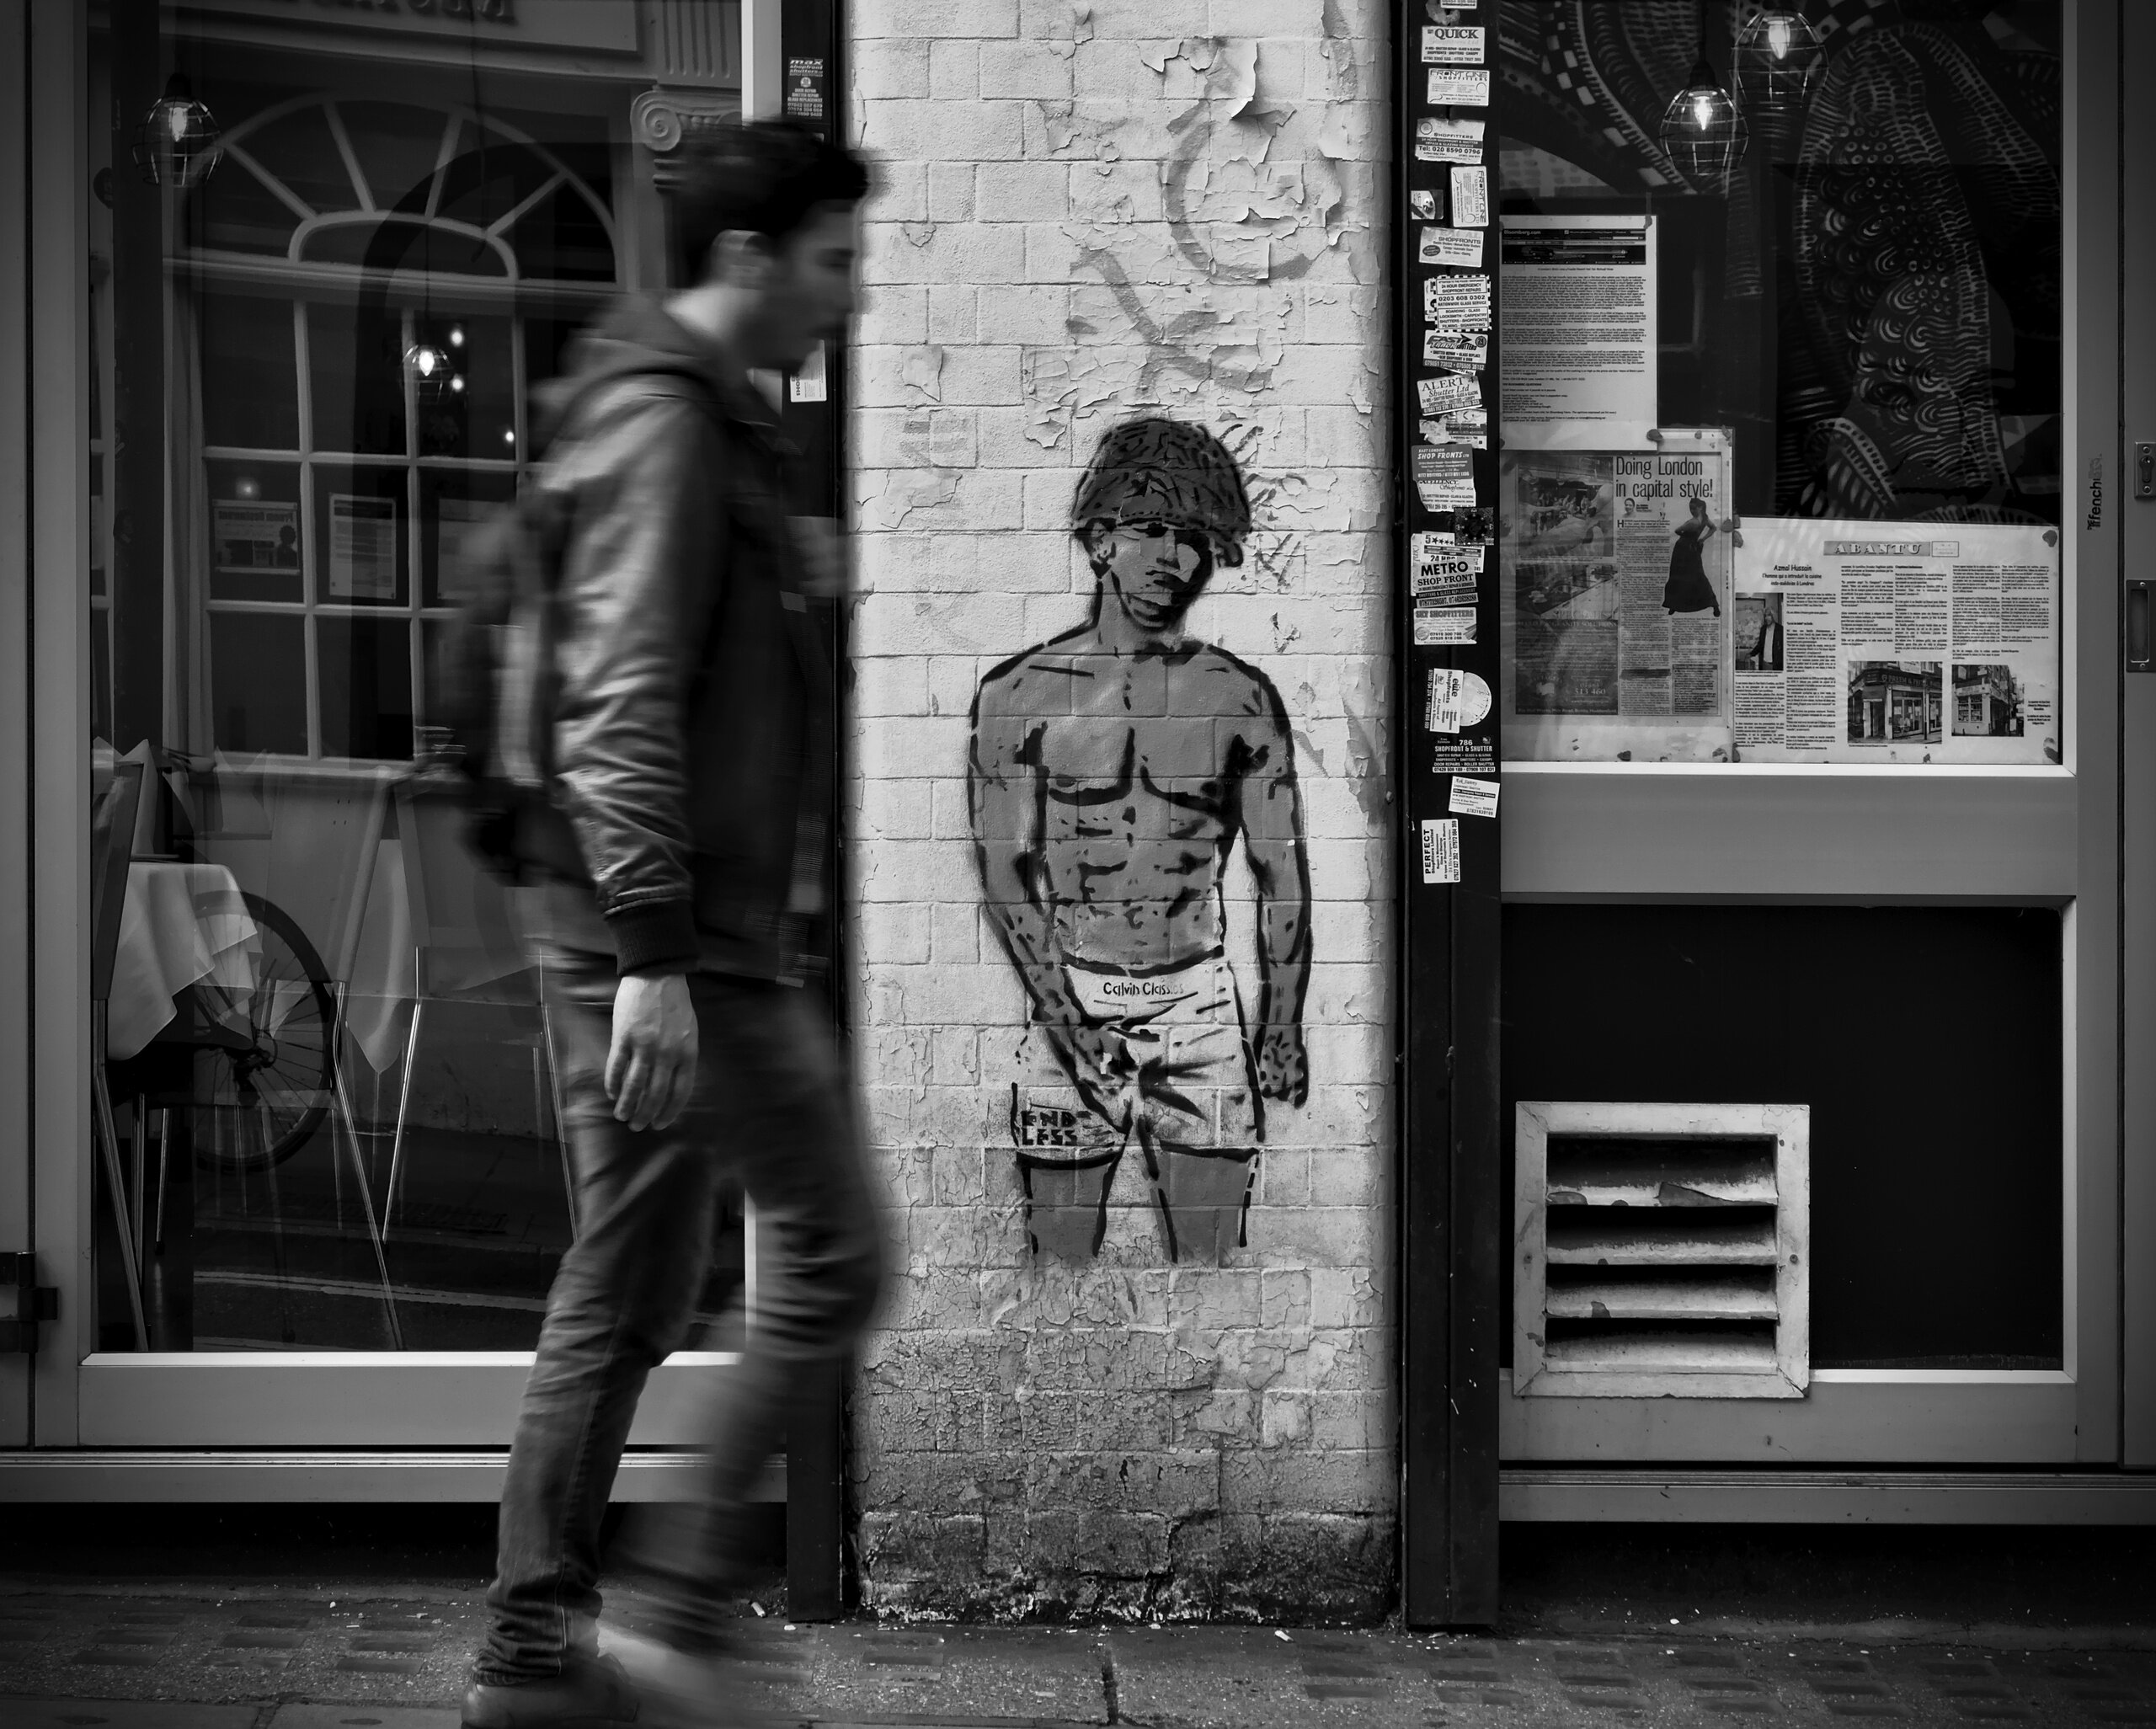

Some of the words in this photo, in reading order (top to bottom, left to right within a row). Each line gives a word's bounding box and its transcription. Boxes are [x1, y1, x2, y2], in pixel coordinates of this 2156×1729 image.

[1434, 29, 1479, 40] QUICK
[1438, 236, 1481, 244] SHOPFRONTS
[1426, 335, 1465, 344] FAST
[1422, 376, 1465, 392] ALERT
[1429, 388, 1454, 398] Shutter
[1457, 384, 1470, 392] Ltd
[1616, 456, 1652, 479] Doing
[1658, 456, 1702, 475] London
[1616, 479, 1625, 497] in
[1633, 479, 1673, 501] capital
[1679, 479, 1713, 499] style!
[1425, 535, 1431, 544] 5
[1834, 543, 1922, 555] ABANTU
[1421, 561, 1468, 576] METRO
[1417, 577, 1441, 586] SHOP
[1444, 574, 1473, 583] FRONT
[1430, 610, 1474, 618] SHOPFITTERS
[1451, 678, 1460, 697] elite
[1103, 981, 1140, 997] Calvin
[1022, 1110, 1076, 1127] END
[1022, 1129, 1078, 1145] LESS
